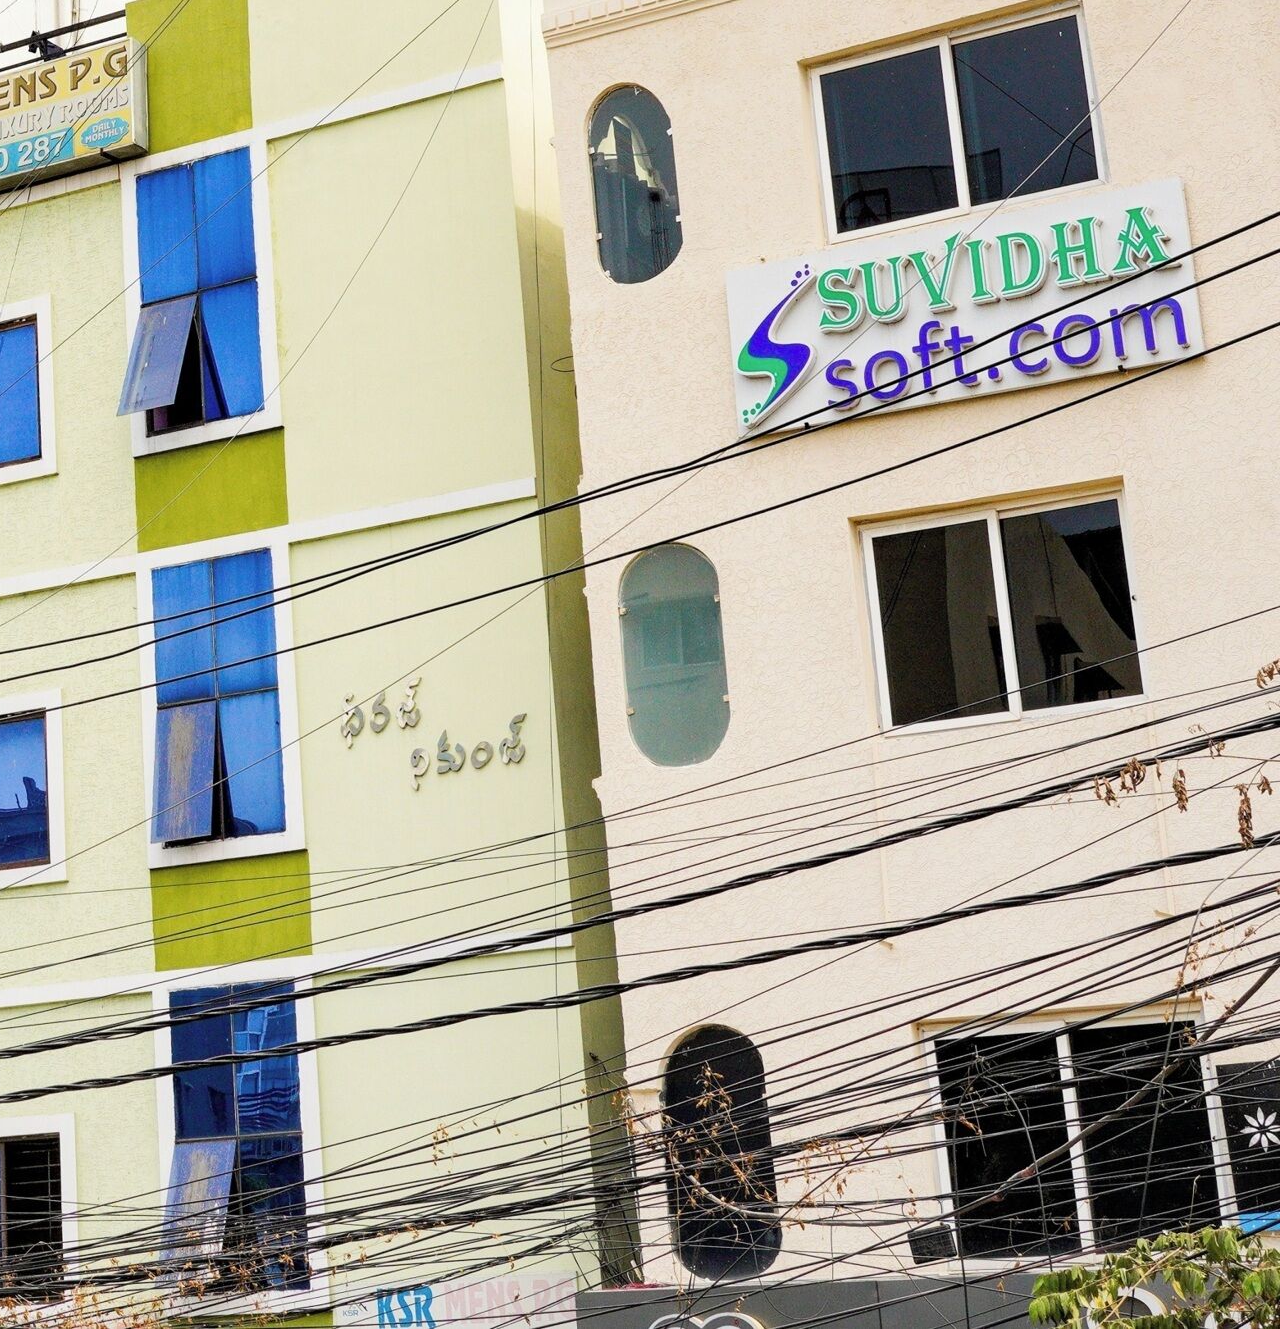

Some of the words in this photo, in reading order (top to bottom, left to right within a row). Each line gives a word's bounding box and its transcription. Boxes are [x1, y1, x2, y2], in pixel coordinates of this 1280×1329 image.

[69, 45, 128, 91] P.G
[59, 86, 129, 124] ROOMS
[85, 126, 124, 143] MONTHLY
[92, 119, 116, 133] DAILY
[16, 131, 67, 168] 287
[816, 205, 1183, 333] SUVIDHA
[826, 296, 1192, 412] soft.com
[342, 1309, 359, 1317] KSR
[377, 1285, 436, 1329] KSR
[444, 1280, 524, 1325] MENS
